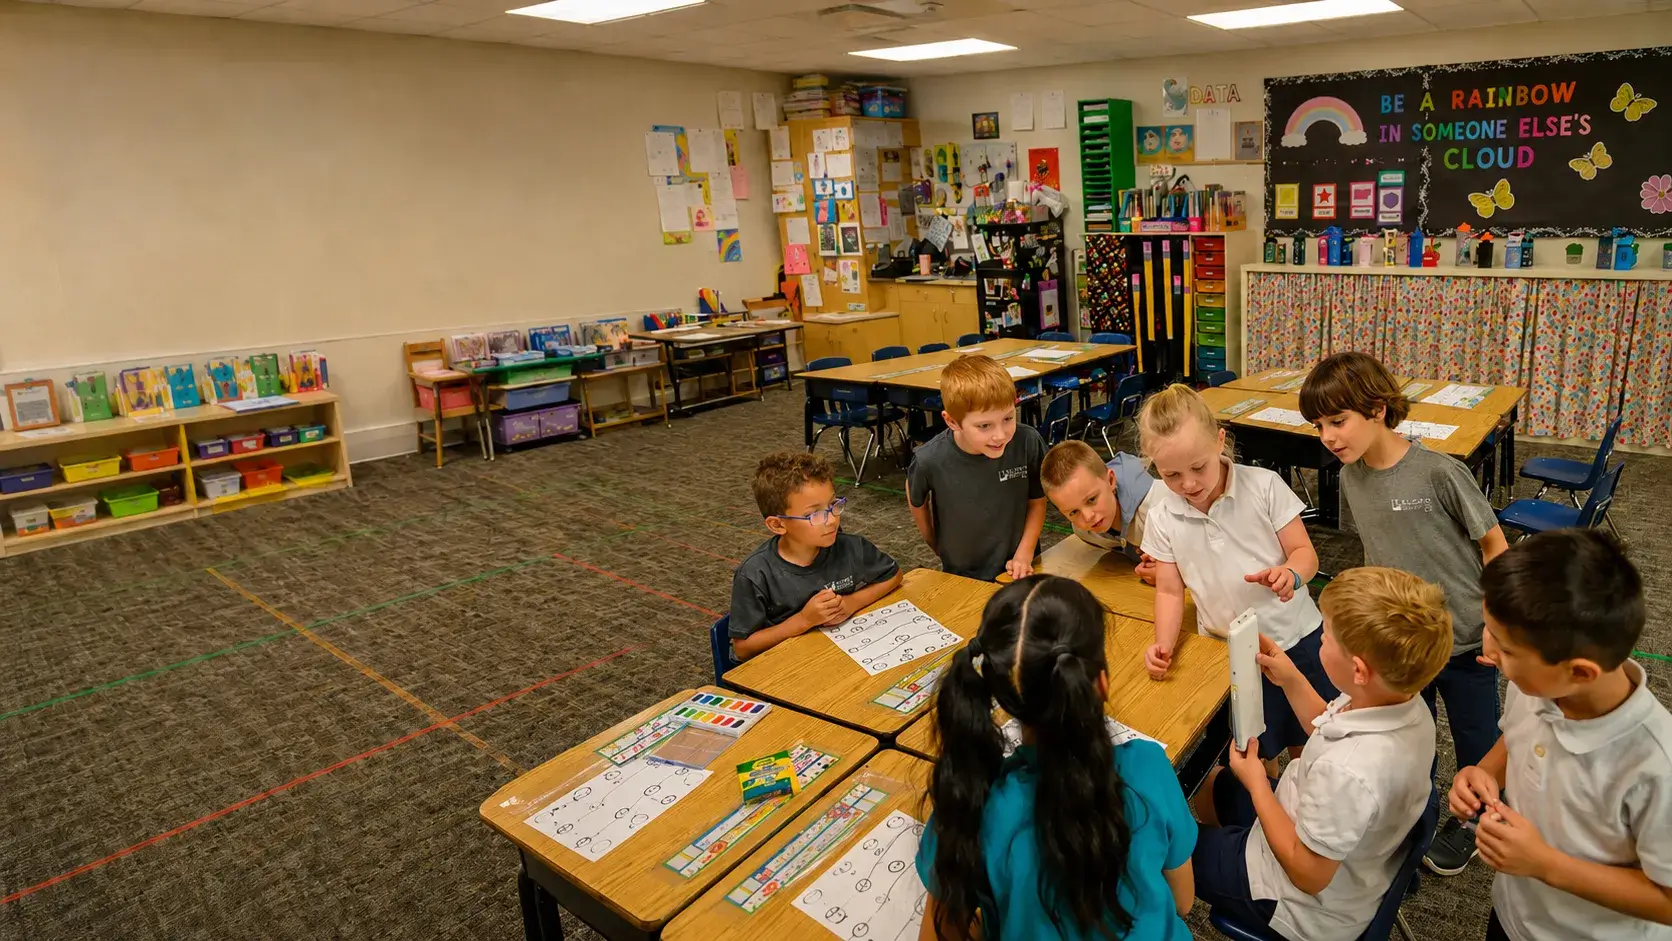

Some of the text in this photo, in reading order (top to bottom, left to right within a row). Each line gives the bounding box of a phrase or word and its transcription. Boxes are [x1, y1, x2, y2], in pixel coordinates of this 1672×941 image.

[1190, 84, 1241, 105] DATA
[1381, 81, 1576, 113] BE A RAINBOW
[1379, 113, 1592, 143] IN SOMEONE ELSE'S
[1443, 145, 1535, 170] CLOUD
